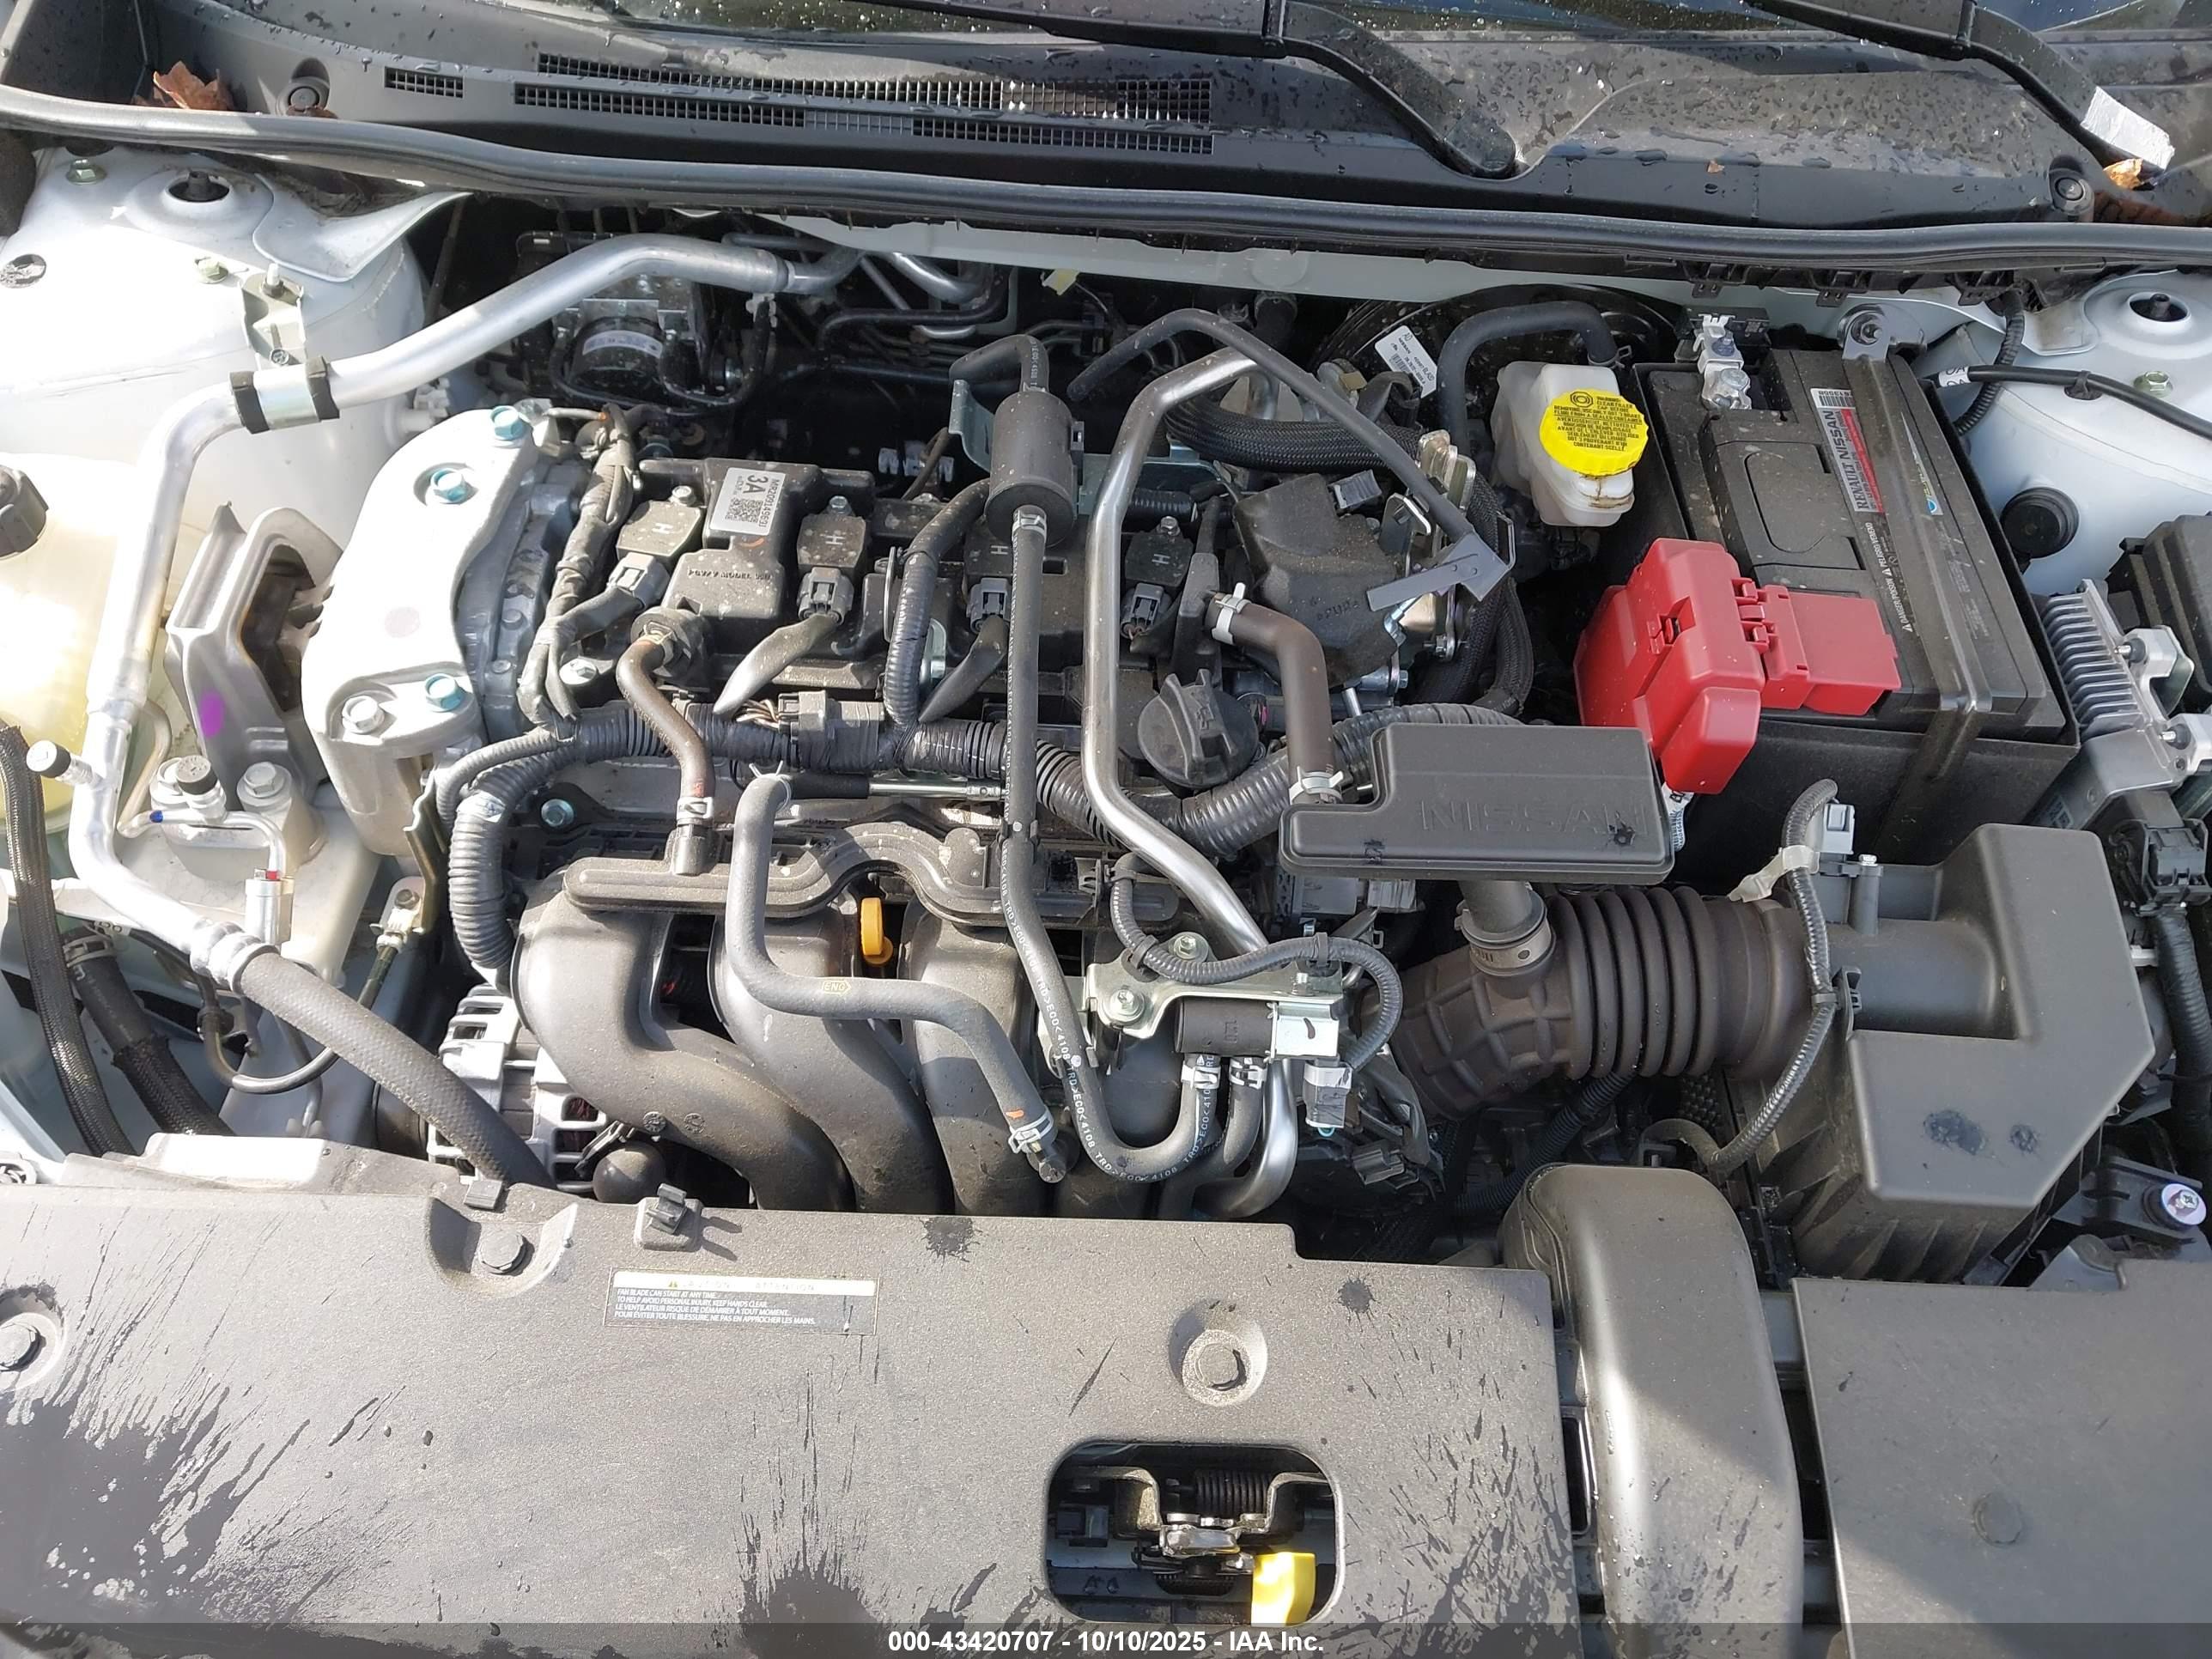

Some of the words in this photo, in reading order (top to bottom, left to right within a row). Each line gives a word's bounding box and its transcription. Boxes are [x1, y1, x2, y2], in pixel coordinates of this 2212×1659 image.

[1822, 410, 1849, 459] NISSAN
[743, 475, 769, 494] 3A
[1845, 463, 1871, 510] RENAULT
[1421, 799, 1648, 836] NISSAN
[824, 982, 847, 991] ENG
